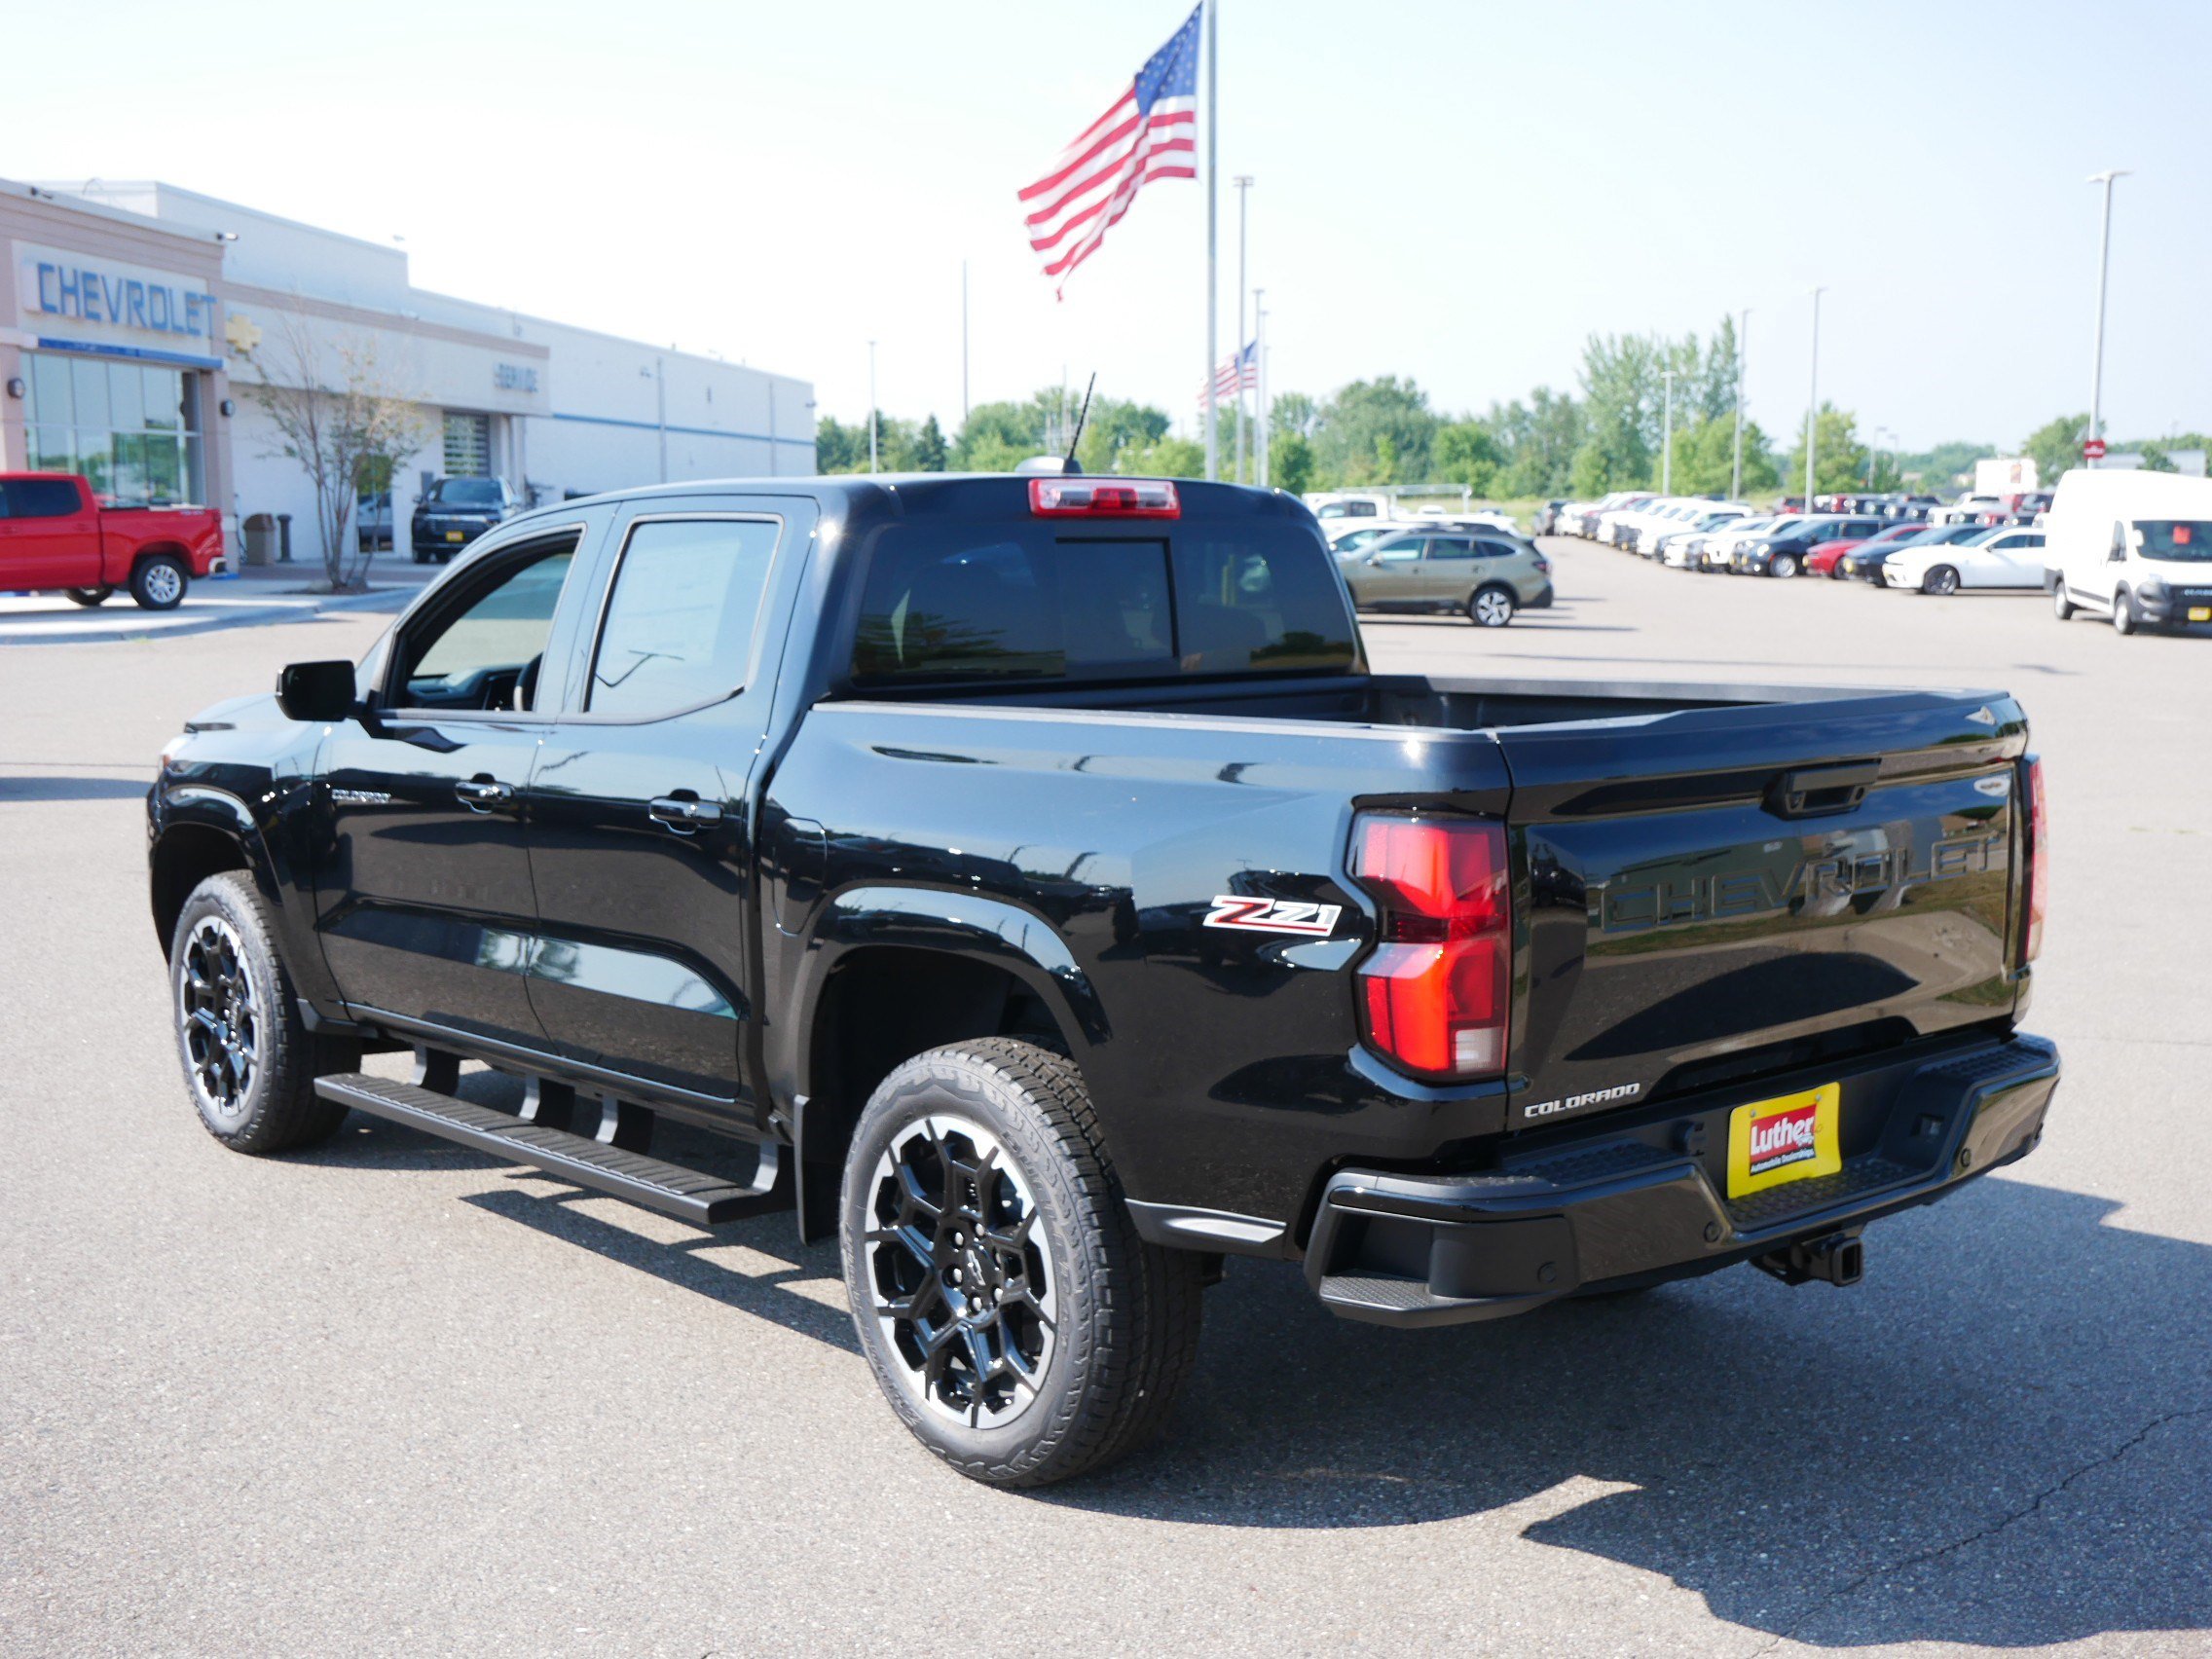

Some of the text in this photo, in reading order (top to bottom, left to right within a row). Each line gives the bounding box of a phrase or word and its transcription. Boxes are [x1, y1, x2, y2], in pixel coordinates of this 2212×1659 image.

[37, 262, 218, 337] CHEVROLET
[1602, 831, 2000, 933] CHEVROLET
[1202, 895, 1343, 937] Z71
[1525, 1083, 1641, 1119] COLORADO
[1751, 1116, 1815, 1156] Luther
